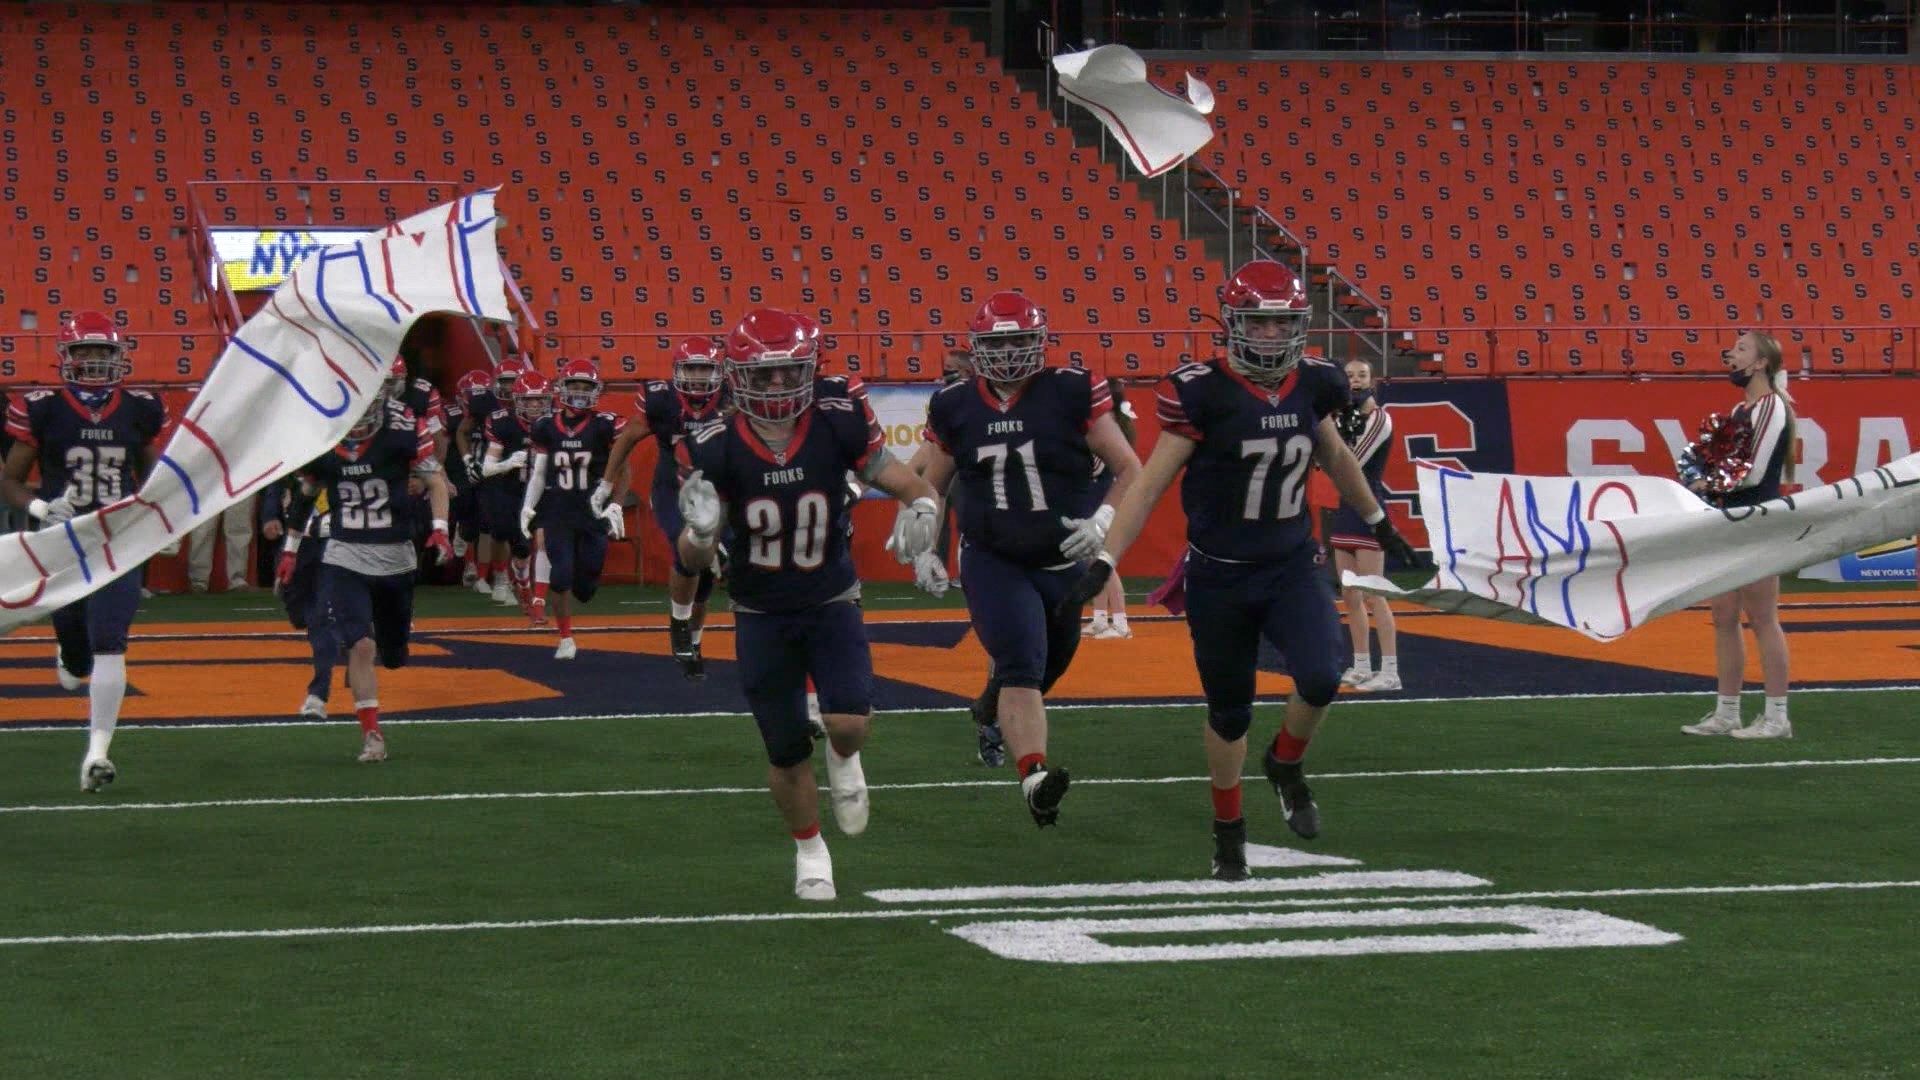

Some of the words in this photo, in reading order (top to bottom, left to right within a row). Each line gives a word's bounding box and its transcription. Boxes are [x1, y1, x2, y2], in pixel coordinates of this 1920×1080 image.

[173, 25, 183, 37] S
[349, 25, 359, 38] S
[437, 26, 446, 38] S
[523, 27, 533, 40] S
[695, 28, 704, 40] S
[904, 32, 914, 43] S
[36, 39, 45, 52] S
[576, 43, 586, 55] S
[130, 57, 140, 70] S
[221, 57, 231, 70] S
[848, 61, 857, 74] S
[1156, 66, 1166, 78] S
[1321, 68, 1330, 79] S
[1404, 68, 1413, 79] S
[1487, 67, 1496, 79] S
[1569, 67, 1578, 79] S
[1768, 67, 1777, 79] S
[82, 76, 92, 88] S
[314, 76, 325, 89] S
[776, 80, 786, 92] S
[947, 82, 958, 94] S
[1218, 81, 1228, 94] S
[1847, 85, 1857, 96] S
[183, 95, 194, 107] S
[506, 95, 516, 108] S
[598, 96, 608, 108] S
[691, 96, 701, 109] S
[1012, 98, 1021, 110] S
[1667, 102, 1677, 113] S
[6, 110, 17, 123] S
[249, 113, 260, 125] S
[341, 113, 352, 125] S
[435, 114, 445, 127] S
[892, 117, 902, 129] S
[1259, 116, 1269, 129] S
[1343, 117, 1352, 129] S
[1483, 119, 1493, 131] S
[1905, 119, 1915, 131] S
[102, 130, 112, 144] S
[630, 133, 641, 146] S
[817, 135, 828, 147] S
[955, 133, 965, 145] S
[1046, 134, 1056, 146] S
[1418, 135, 1428, 148] S
[1555, 136, 1564, 148] S
[1724, 136, 1733, 148] S
[1807, 137, 1817, 149] S
[205, 149, 216, 164] S
[299, 149, 310, 163] S
[541, 152, 552, 165] S
[684, 153, 695, 166] S
[740, 153, 751, 166] S
[1306, 153, 1317, 167] S
[157, 169, 168, 183] S
[465, 171, 476, 184] S
[898, 172, 909, 183] S
[1089, 170, 1099, 183] S
[1238, 171, 1248, 183] S
[1466, 171, 1476, 183] S
[1645, 172, 1655, 184] S
[1868, 172, 1878, 184] S
[5, 188, 16, 202] S
[380, 190, 391, 203] S
[632, 189, 644, 203] S
[966, 188, 978, 202] S
[1016, 188, 1027, 202] S
[1395, 189, 1406, 201] S
[1586, 188, 1596, 201] S
[1718, 189, 1729, 202] S
[69, 209, 81, 222] S
[276, 208, 288, 222] S
[740, 209, 752, 222] S
[1126, 209, 1137, 221] S
[1286, 208, 1296, 221] S
[1515, 206, 1526, 219] S
[1794, 207, 1805, 220] S
[140, 227, 152, 241] S
[543, 228, 555, 242] S
[801, 227, 813, 241] S
[1055, 227, 1066, 241] S
[1873, 225, 1884, 238] S
[603, 247, 615, 261] S
[661, 247, 673, 261] S
[970, 248, 982, 261] S
[1424, 246, 1434, 260] S
[1612, 245, 1623, 259] S
[1705, 244, 1716, 259] S
[36, 269, 48, 283] S
[721, 267, 733, 282] S
[889, 267, 901, 282] S
[1135, 268, 1147, 282] S
[1194, 268, 1206, 282] S
[1357, 265, 1367, 280] S
[1657, 264, 1668, 278] S
[1749, 265, 1761, 279] S
[105, 289, 117, 305] S
[160, 290, 172, 306] S
[1064, 289, 1076, 304] S
[1526, 285, 1537, 300] S
[1856, 285, 1868, 299] S
[711, 311, 724, 326] S
[821, 310, 833, 325] S
[879, 311, 891, 327] S
[930, 310, 942, 325] S
[1139, 309, 1152, 324] S
[1410, 308, 1422, 322] S
[1464, 308, 1476, 323] S
[1679, 305, 1691, 321] S
[1783, 305, 1794, 320] S
[546, 312, 559, 328] S
[656, 313, 669, 328] S
[182, 336, 195, 352] S
[1127, 355, 1140, 370] S
[1466, 354, 1478, 369] S
[1570, 351, 1582, 366] S
[1672, 353, 1686, 366] S
[1833, 349, 1845, 365] S
[3, 361, 16, 376] S
[623, 357, 636, 373] S
[848, 356, 861, 372] S
[909, 358, 921, 374] S
[988, 420, 1024, 435] FORKS
[1261, 413, 1299, 430] FORKS
[80, 429, 114, 440] FORKS
[65, 445, 126, 508] 35
[342, 464, 372, 476] FORKS
[554, 450, 592, 490] 37
[763, 467, 805, 486] FORKS
[976, 439, 1049, 512] 71
[1240, 434, 1313, 520] 72
[337, 478, 392, 530] 22
[745, 490, 829, 570] 20
[1860, 569, 1881, 577] NEW
[1881, 569, 1905, 577] YORK
